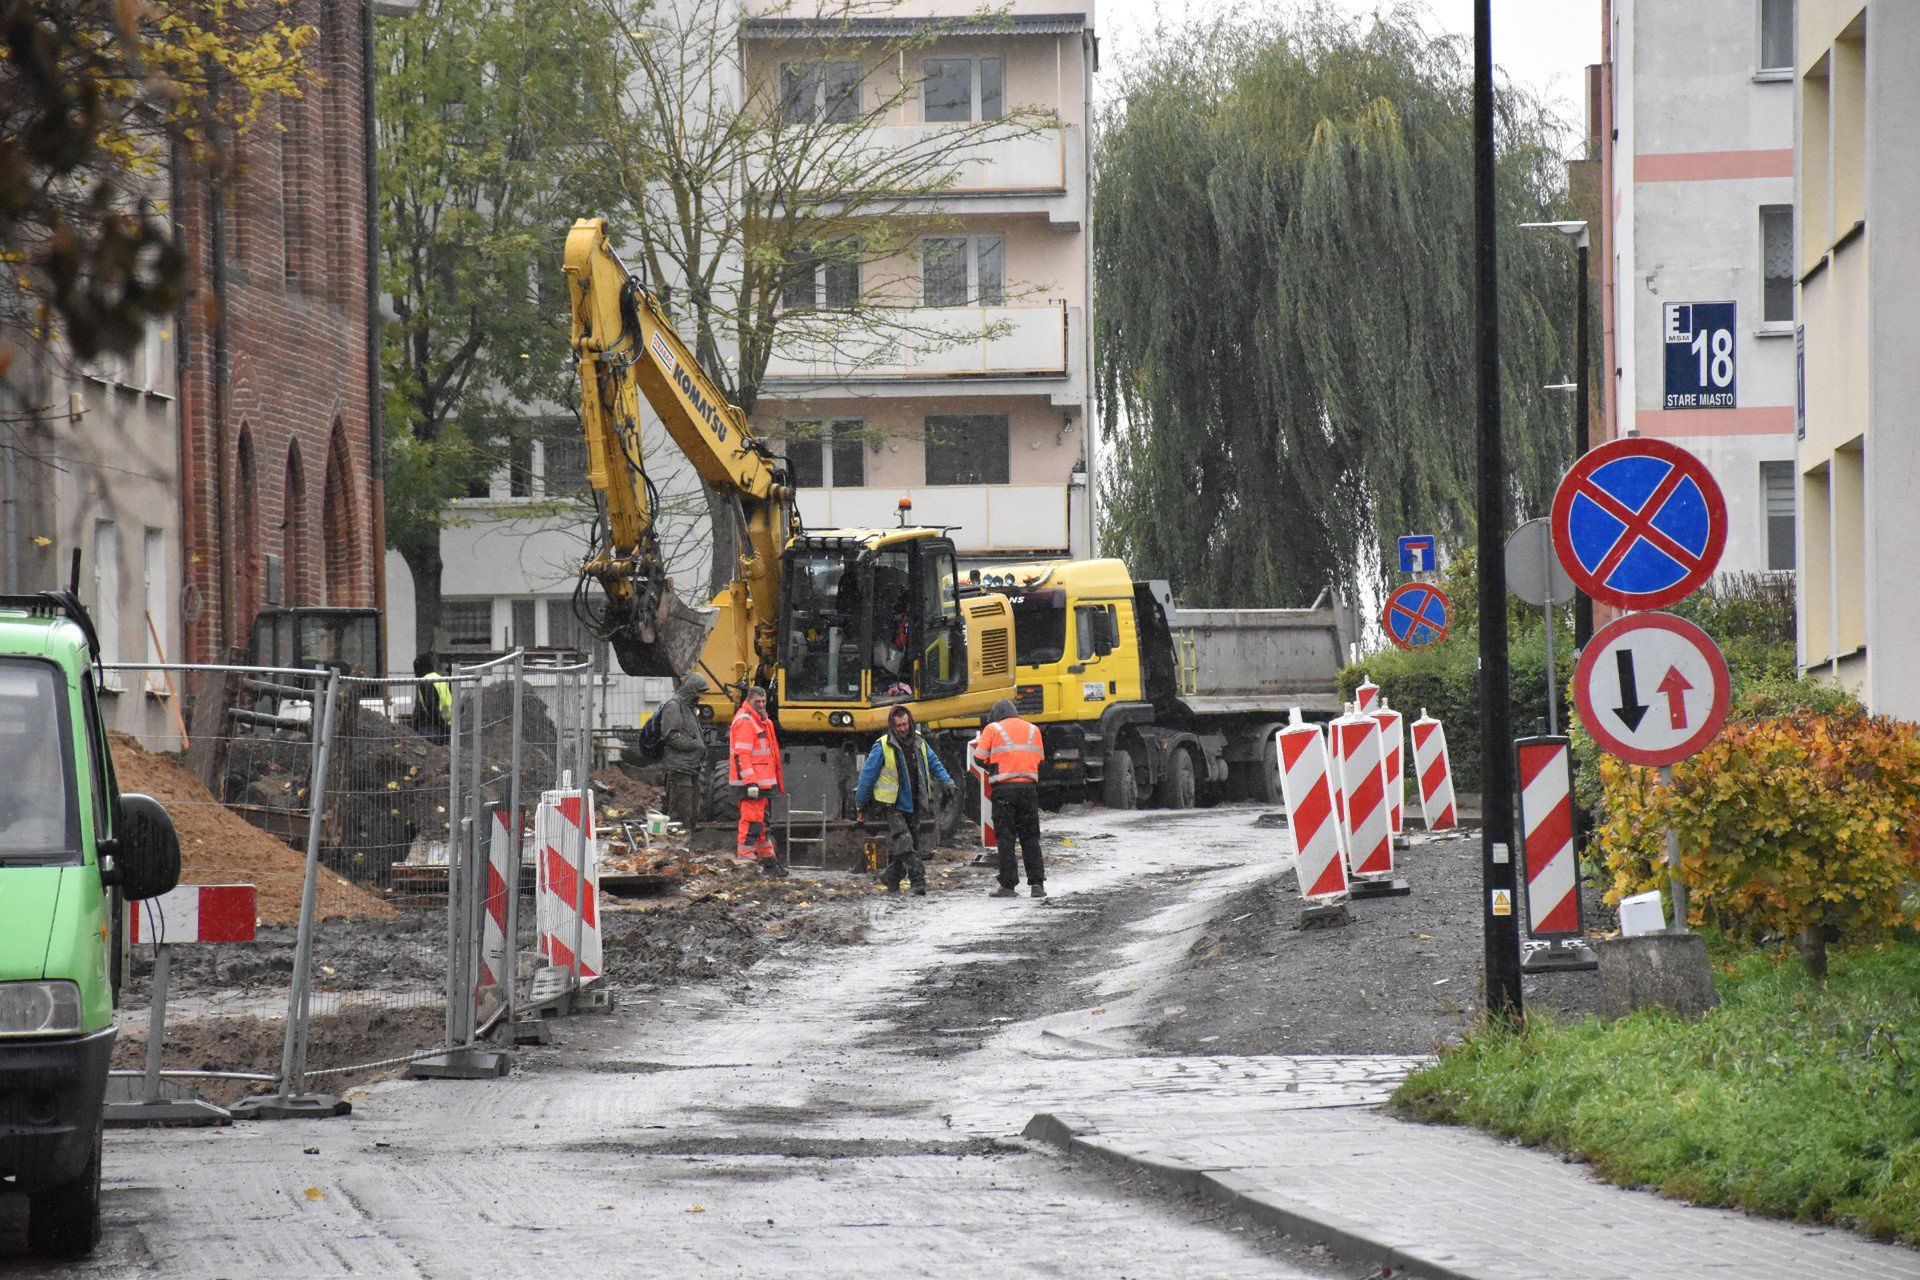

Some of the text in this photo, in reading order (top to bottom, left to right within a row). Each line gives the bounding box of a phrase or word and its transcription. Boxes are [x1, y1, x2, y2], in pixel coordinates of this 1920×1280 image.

[1692, 328, 1734, 387] 18
[673, 363, 727, 442] KOMATSU
[1667, 393, 1733, 406] STARE MIASTO
